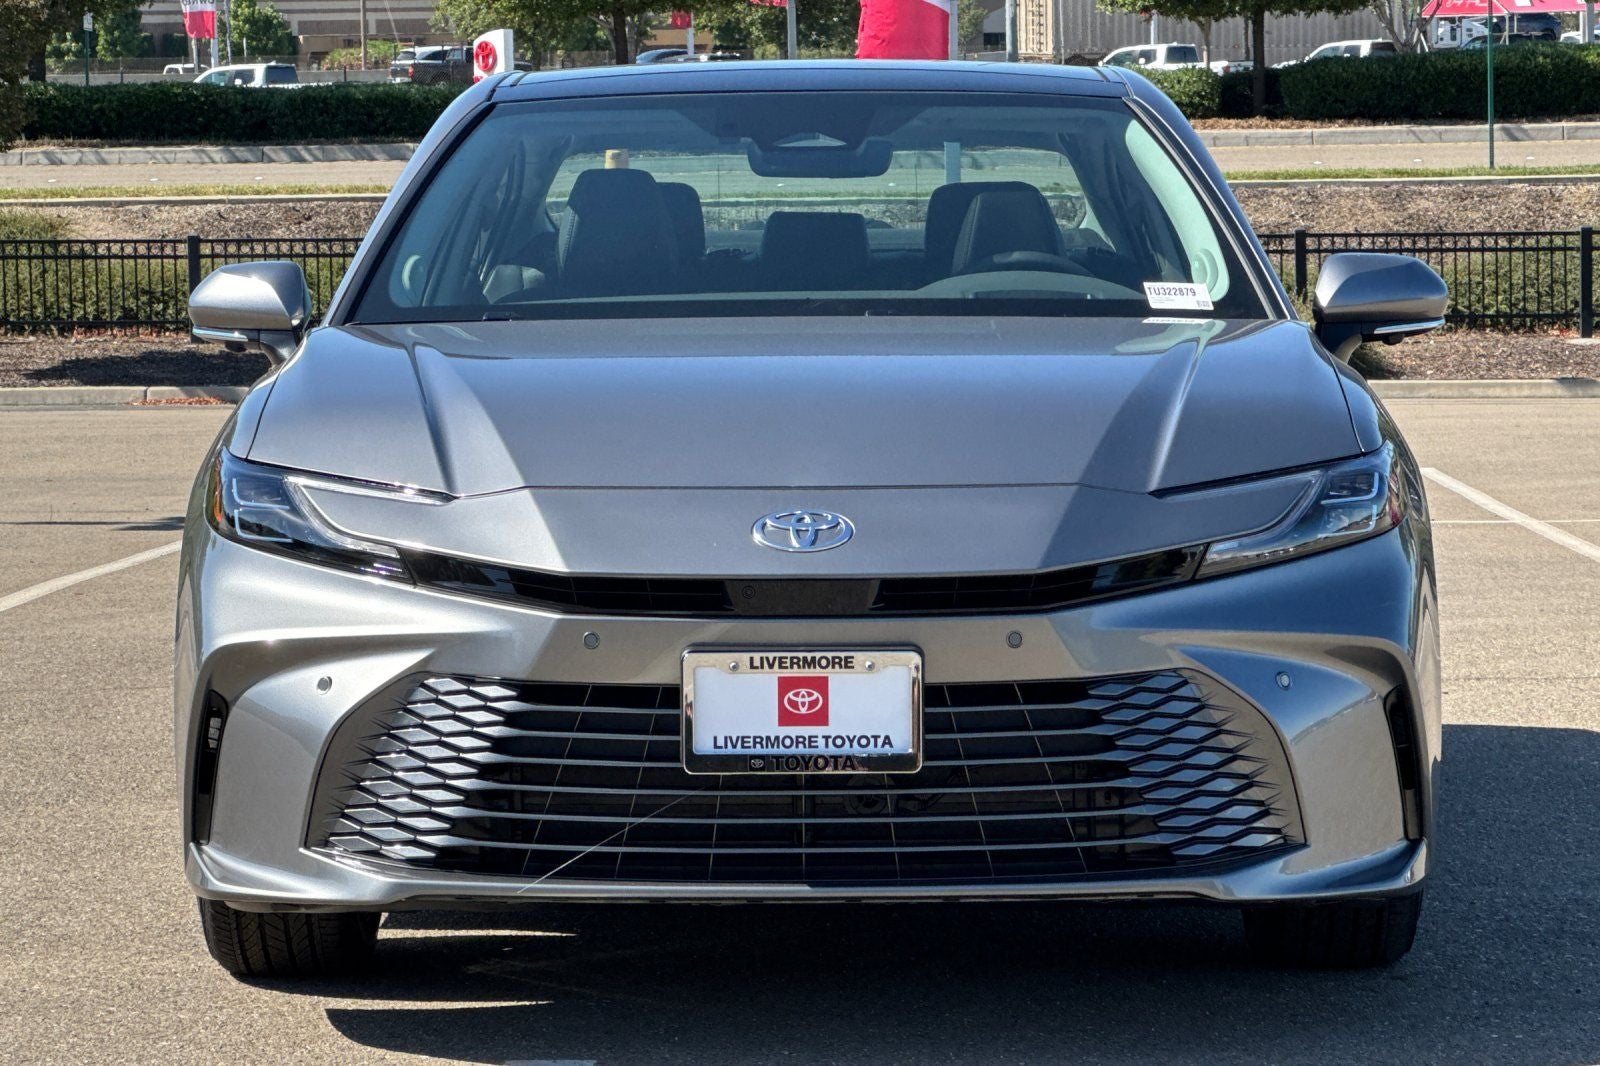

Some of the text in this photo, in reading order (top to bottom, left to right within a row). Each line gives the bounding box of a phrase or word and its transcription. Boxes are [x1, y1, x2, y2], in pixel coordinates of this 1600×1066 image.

[1147, 286, 1197, 297] TU322879
[749, 655, 855, 670] LIVERMORE
[713, 734, 894, 750] LIVERMORE TOYOTA
[771, 755, 857, 771] TOYOTA
